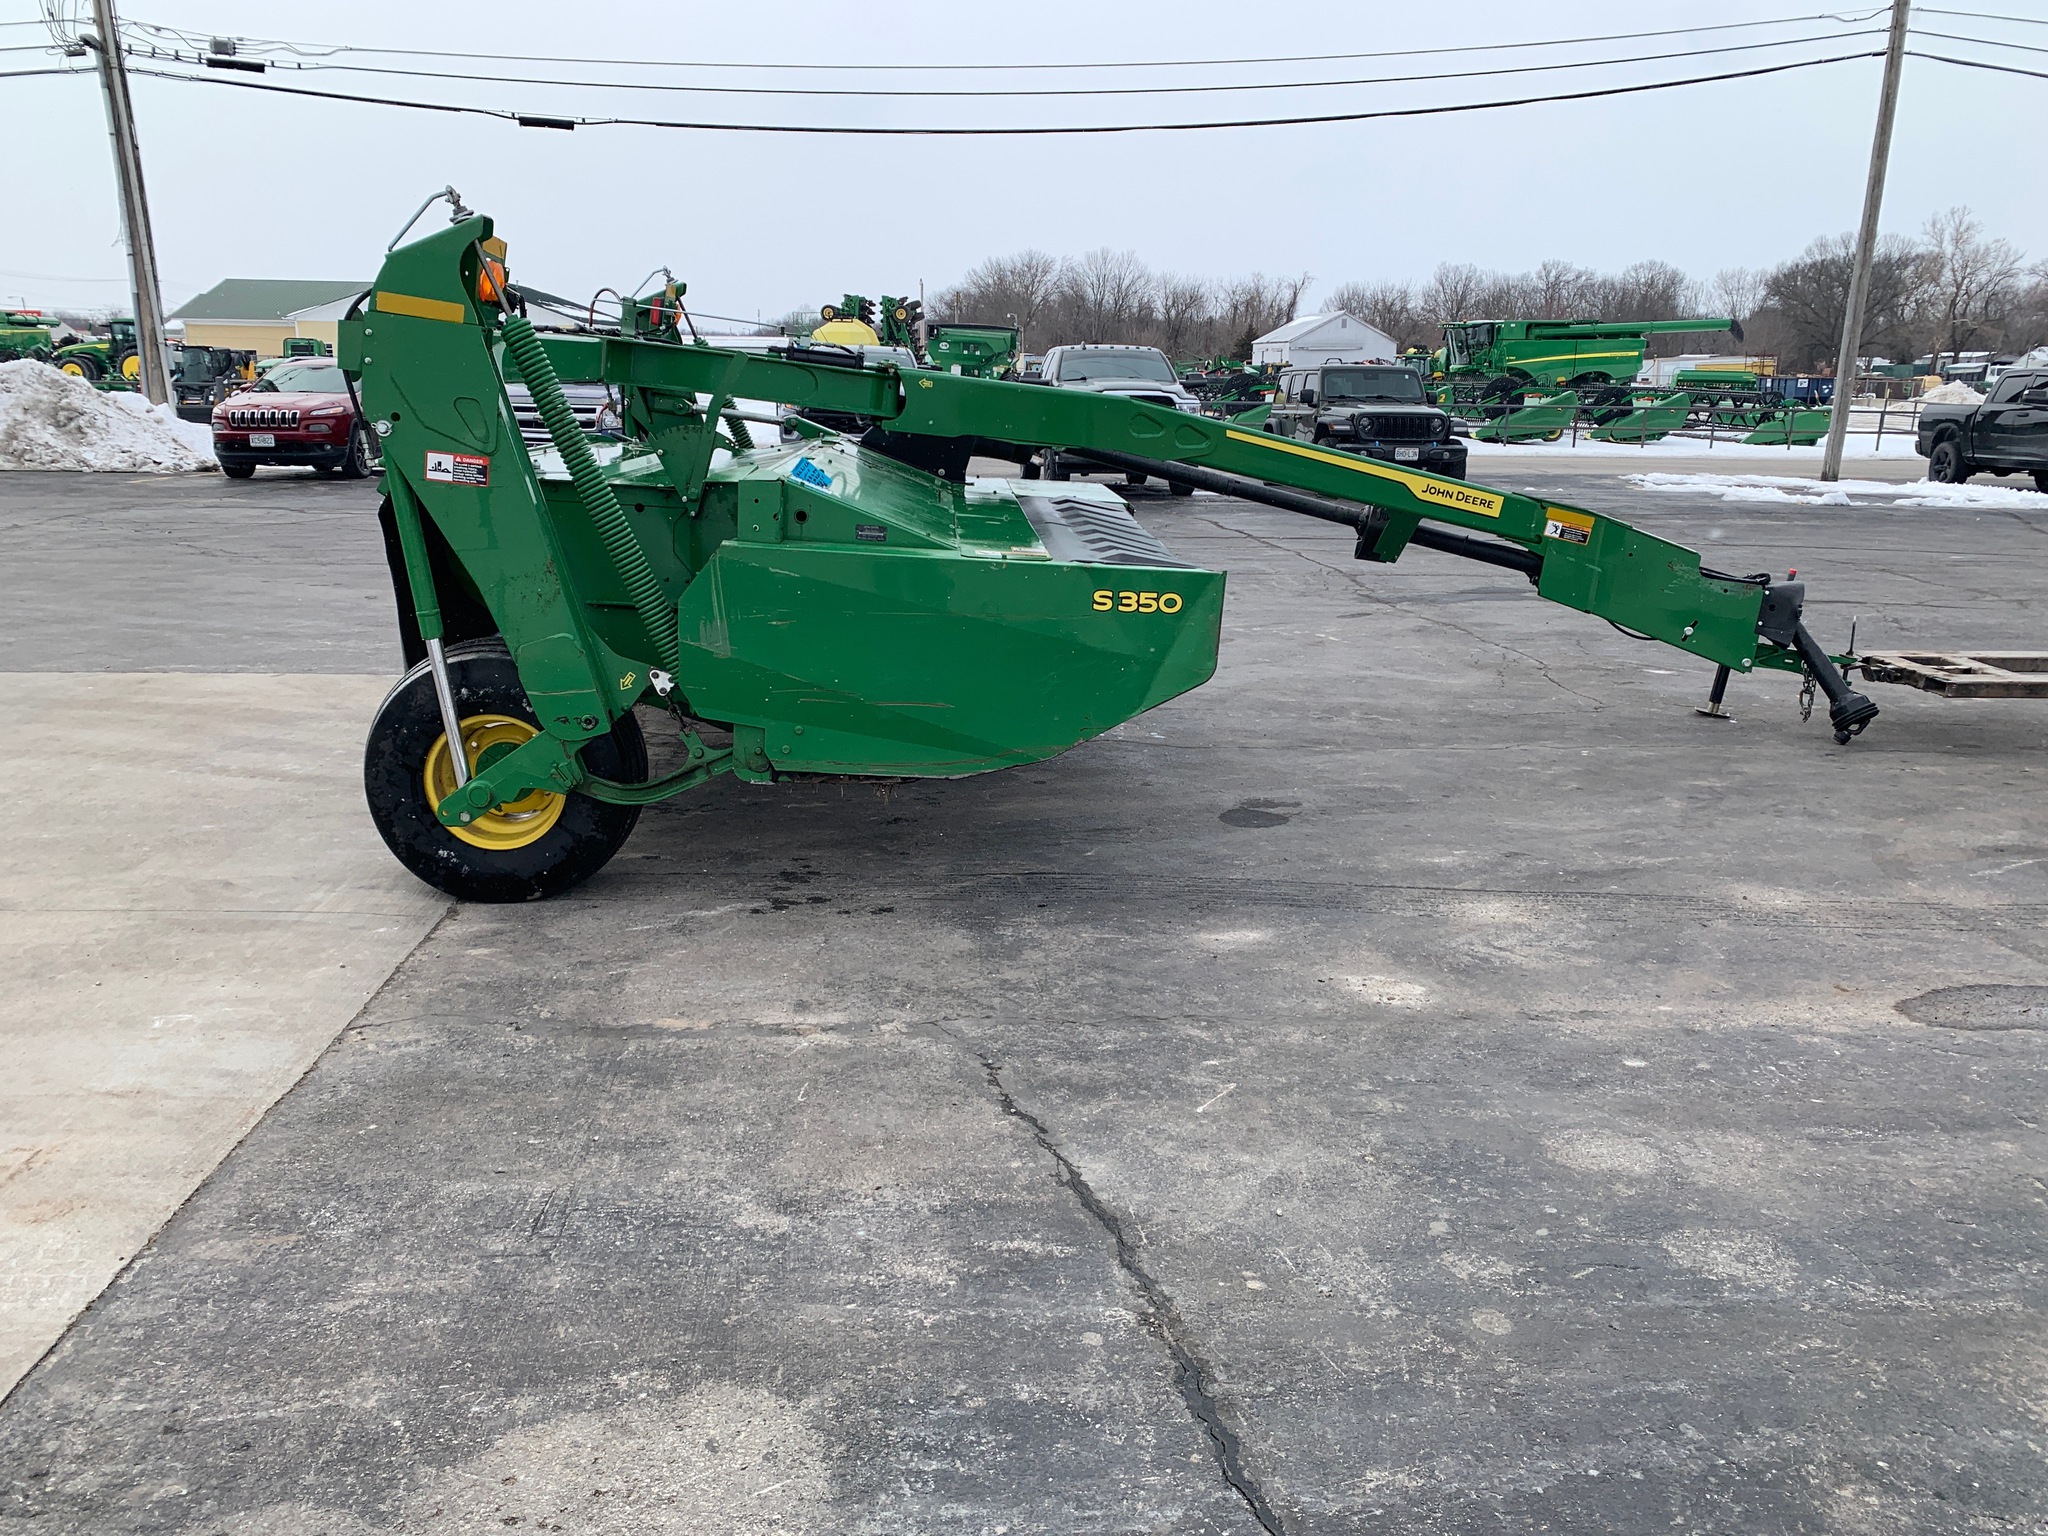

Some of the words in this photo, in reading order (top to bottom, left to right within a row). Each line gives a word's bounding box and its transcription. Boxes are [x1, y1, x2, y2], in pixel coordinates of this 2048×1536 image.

[462, 457, 484, 465] DANGER
[1421, 483, 1454, 500] JOHN
[1456, 490, 1495, 510] DEERE
[1092, 589, 1114, 612] S
[1118, 591, 1182, 613] 350
